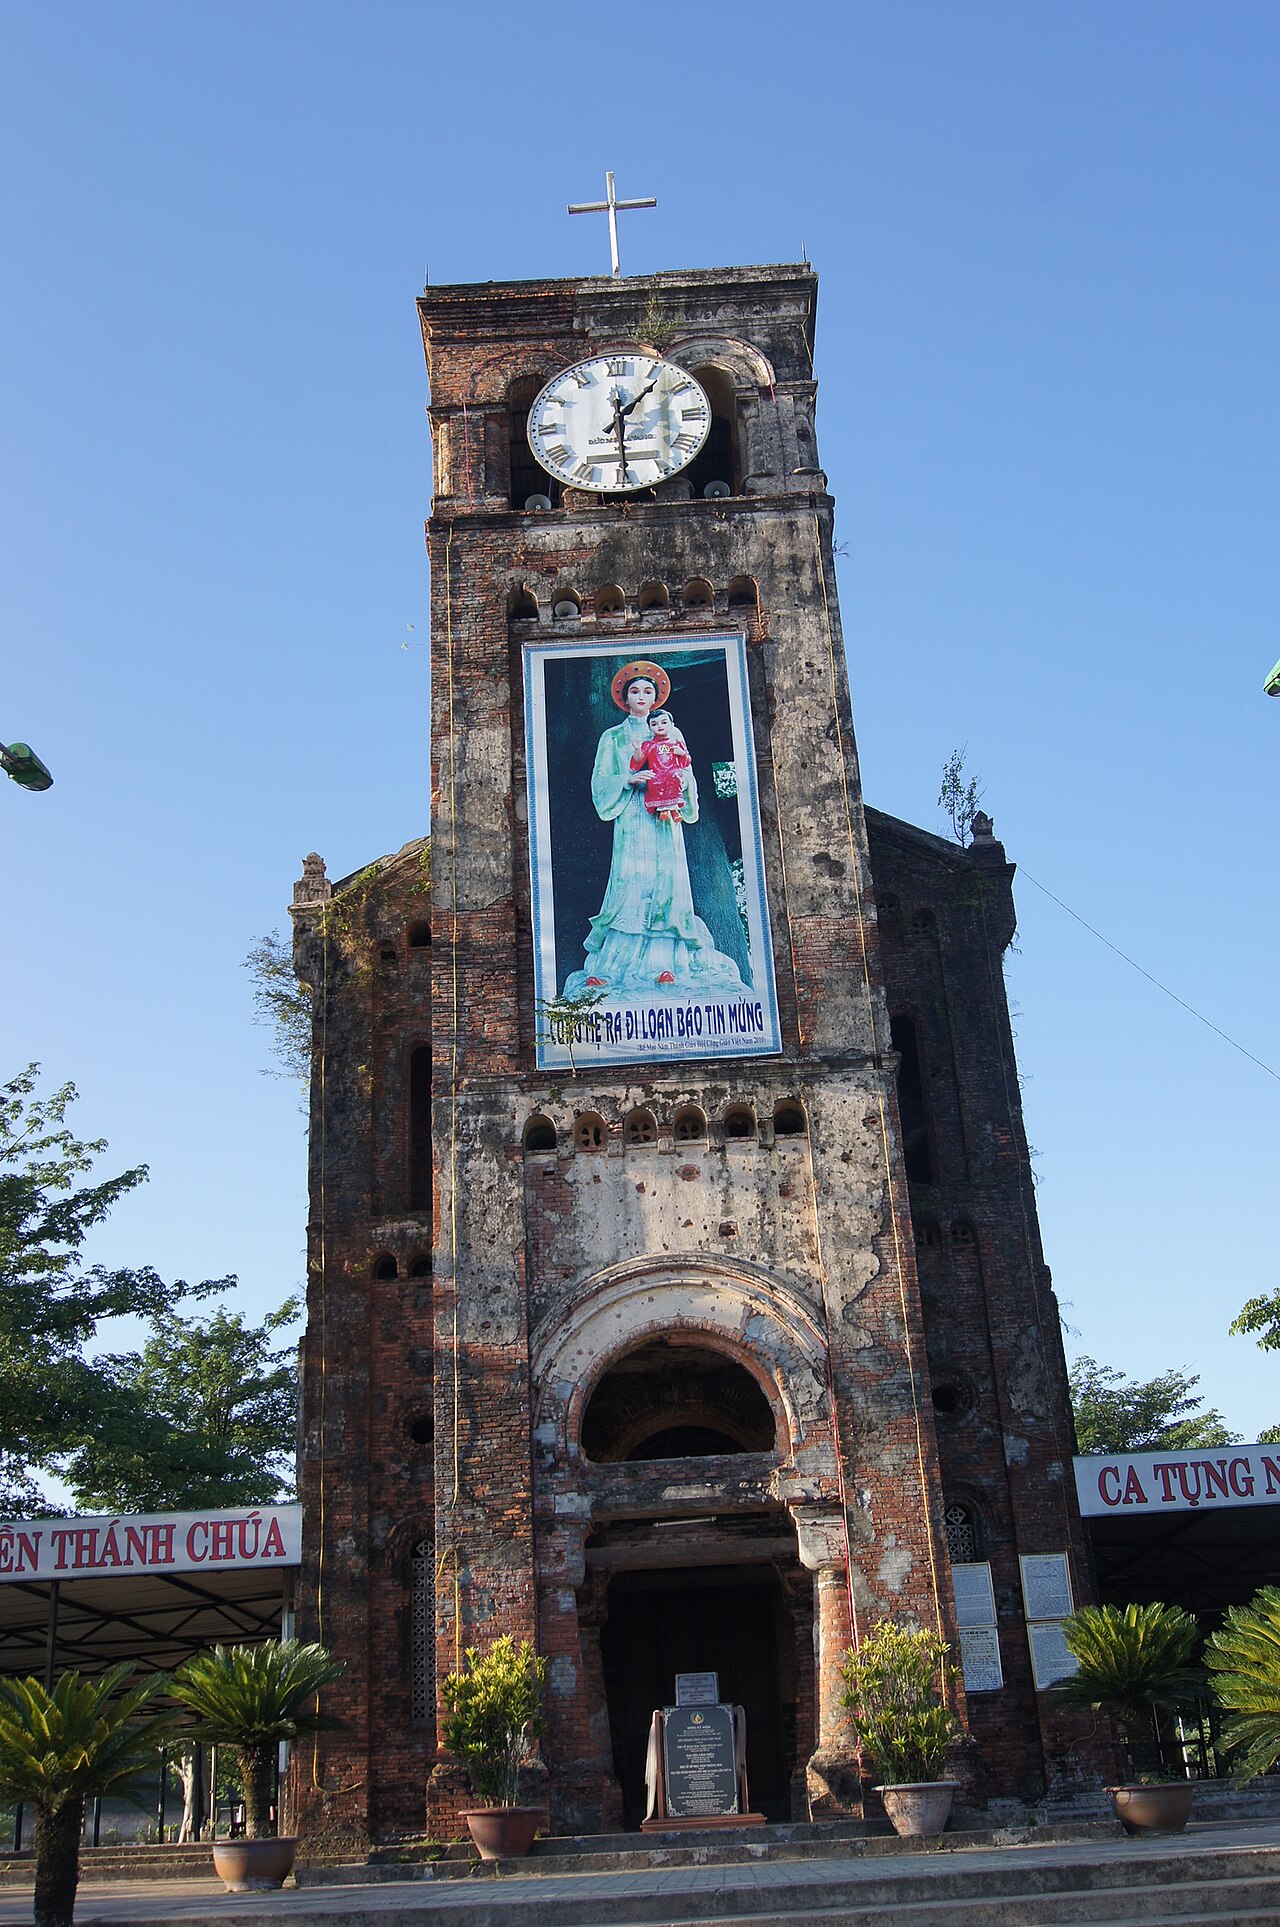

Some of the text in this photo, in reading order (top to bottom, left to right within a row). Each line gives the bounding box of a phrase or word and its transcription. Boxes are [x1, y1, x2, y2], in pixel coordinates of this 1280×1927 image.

[606, 1011, 622, 1044] RA
[626, 1010, 639, 1041] ĐI
[642, 1008, 674, 1041] LOAN
[677, 999, 702, 1039] BÁO
[705, 1004, 726, 1035] TIN
[728, 996, 764, 1033] MỪNG
[1097, 1465, 1149, 1506] CA
[1153, 1457, 1255, 1507] TỤNG
[51, 1519, 176, 1570] THÁNH
[186, 1511, 287, 1563] CHÚA
